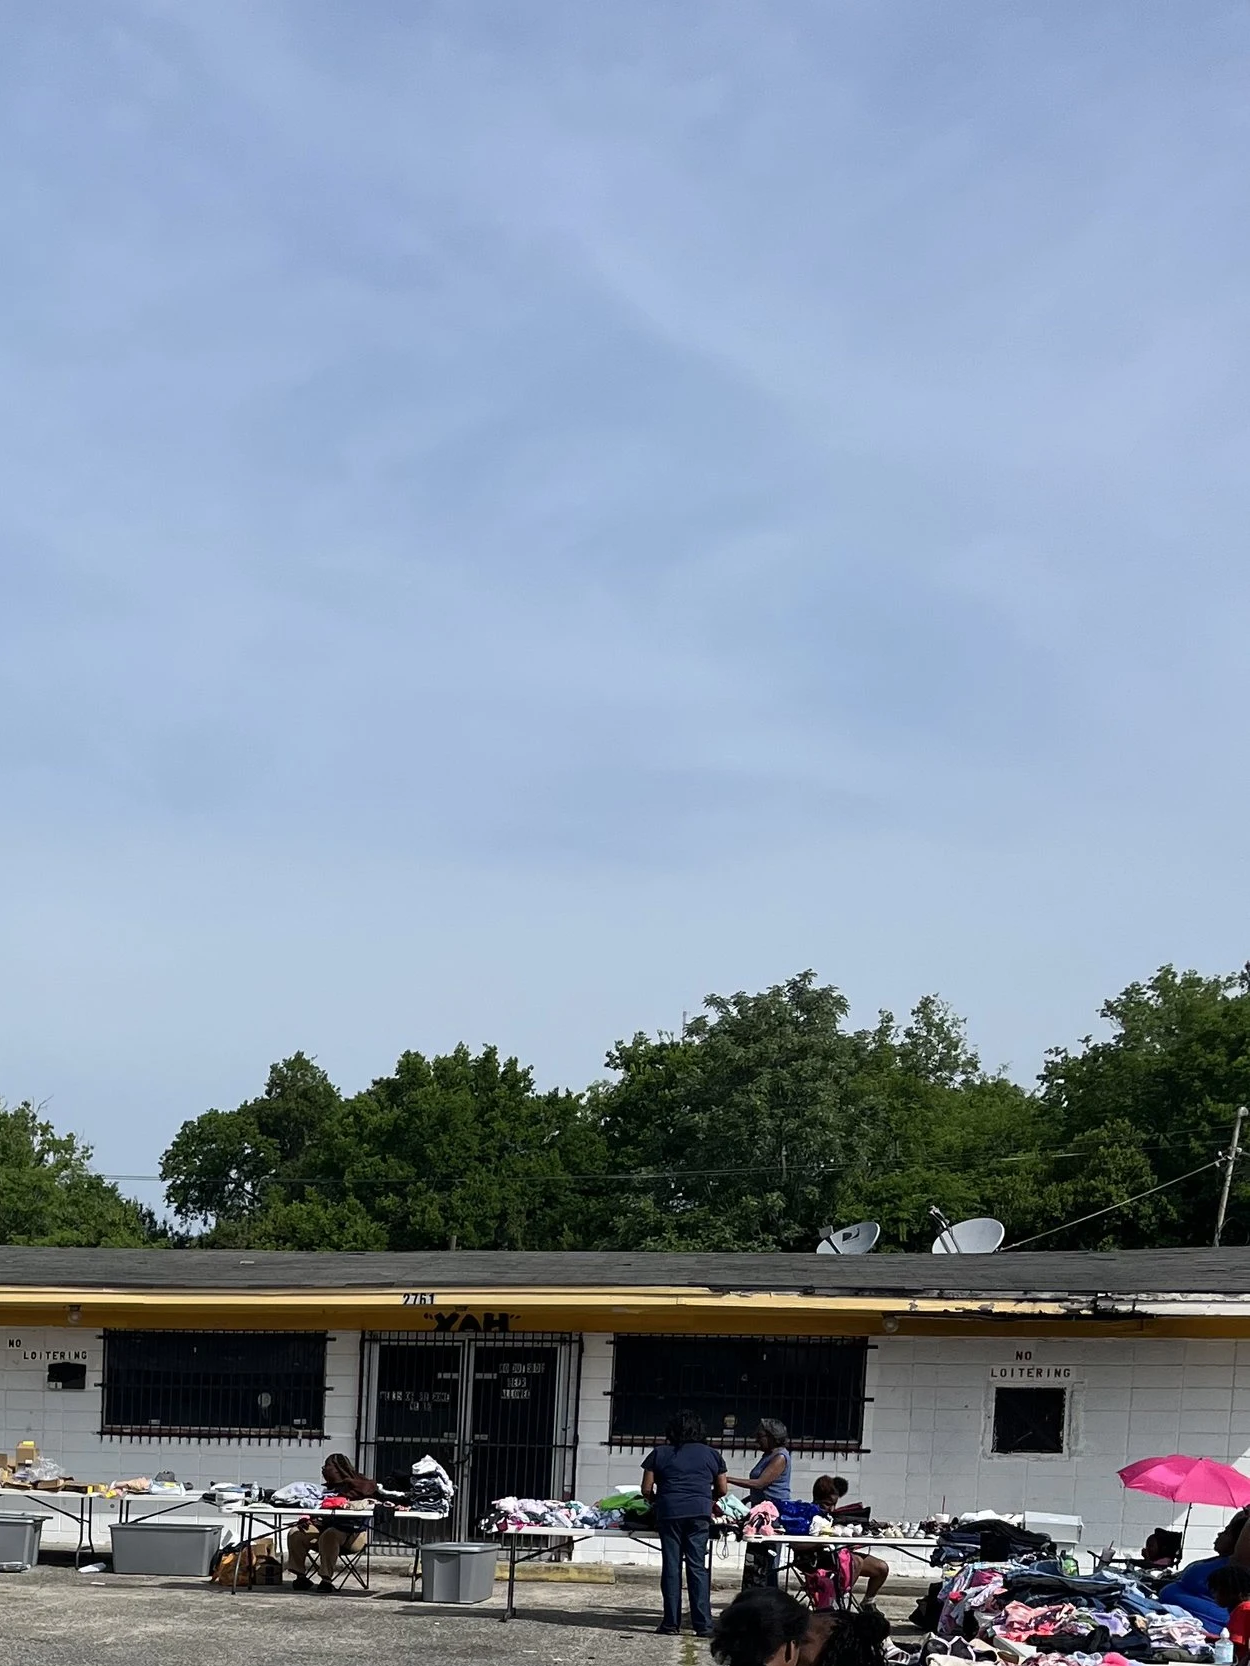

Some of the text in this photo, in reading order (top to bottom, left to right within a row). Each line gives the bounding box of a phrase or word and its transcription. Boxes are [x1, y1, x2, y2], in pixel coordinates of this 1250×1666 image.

[402, 1292, 436, 1305] 2761
[8, 1338, 22, 1348] NO
[23, 1350, 88, 1360] LOITERING
[1015, 1350, 1032, 1361] NO
[990, 1367, 1071, 1378] LOITERING
